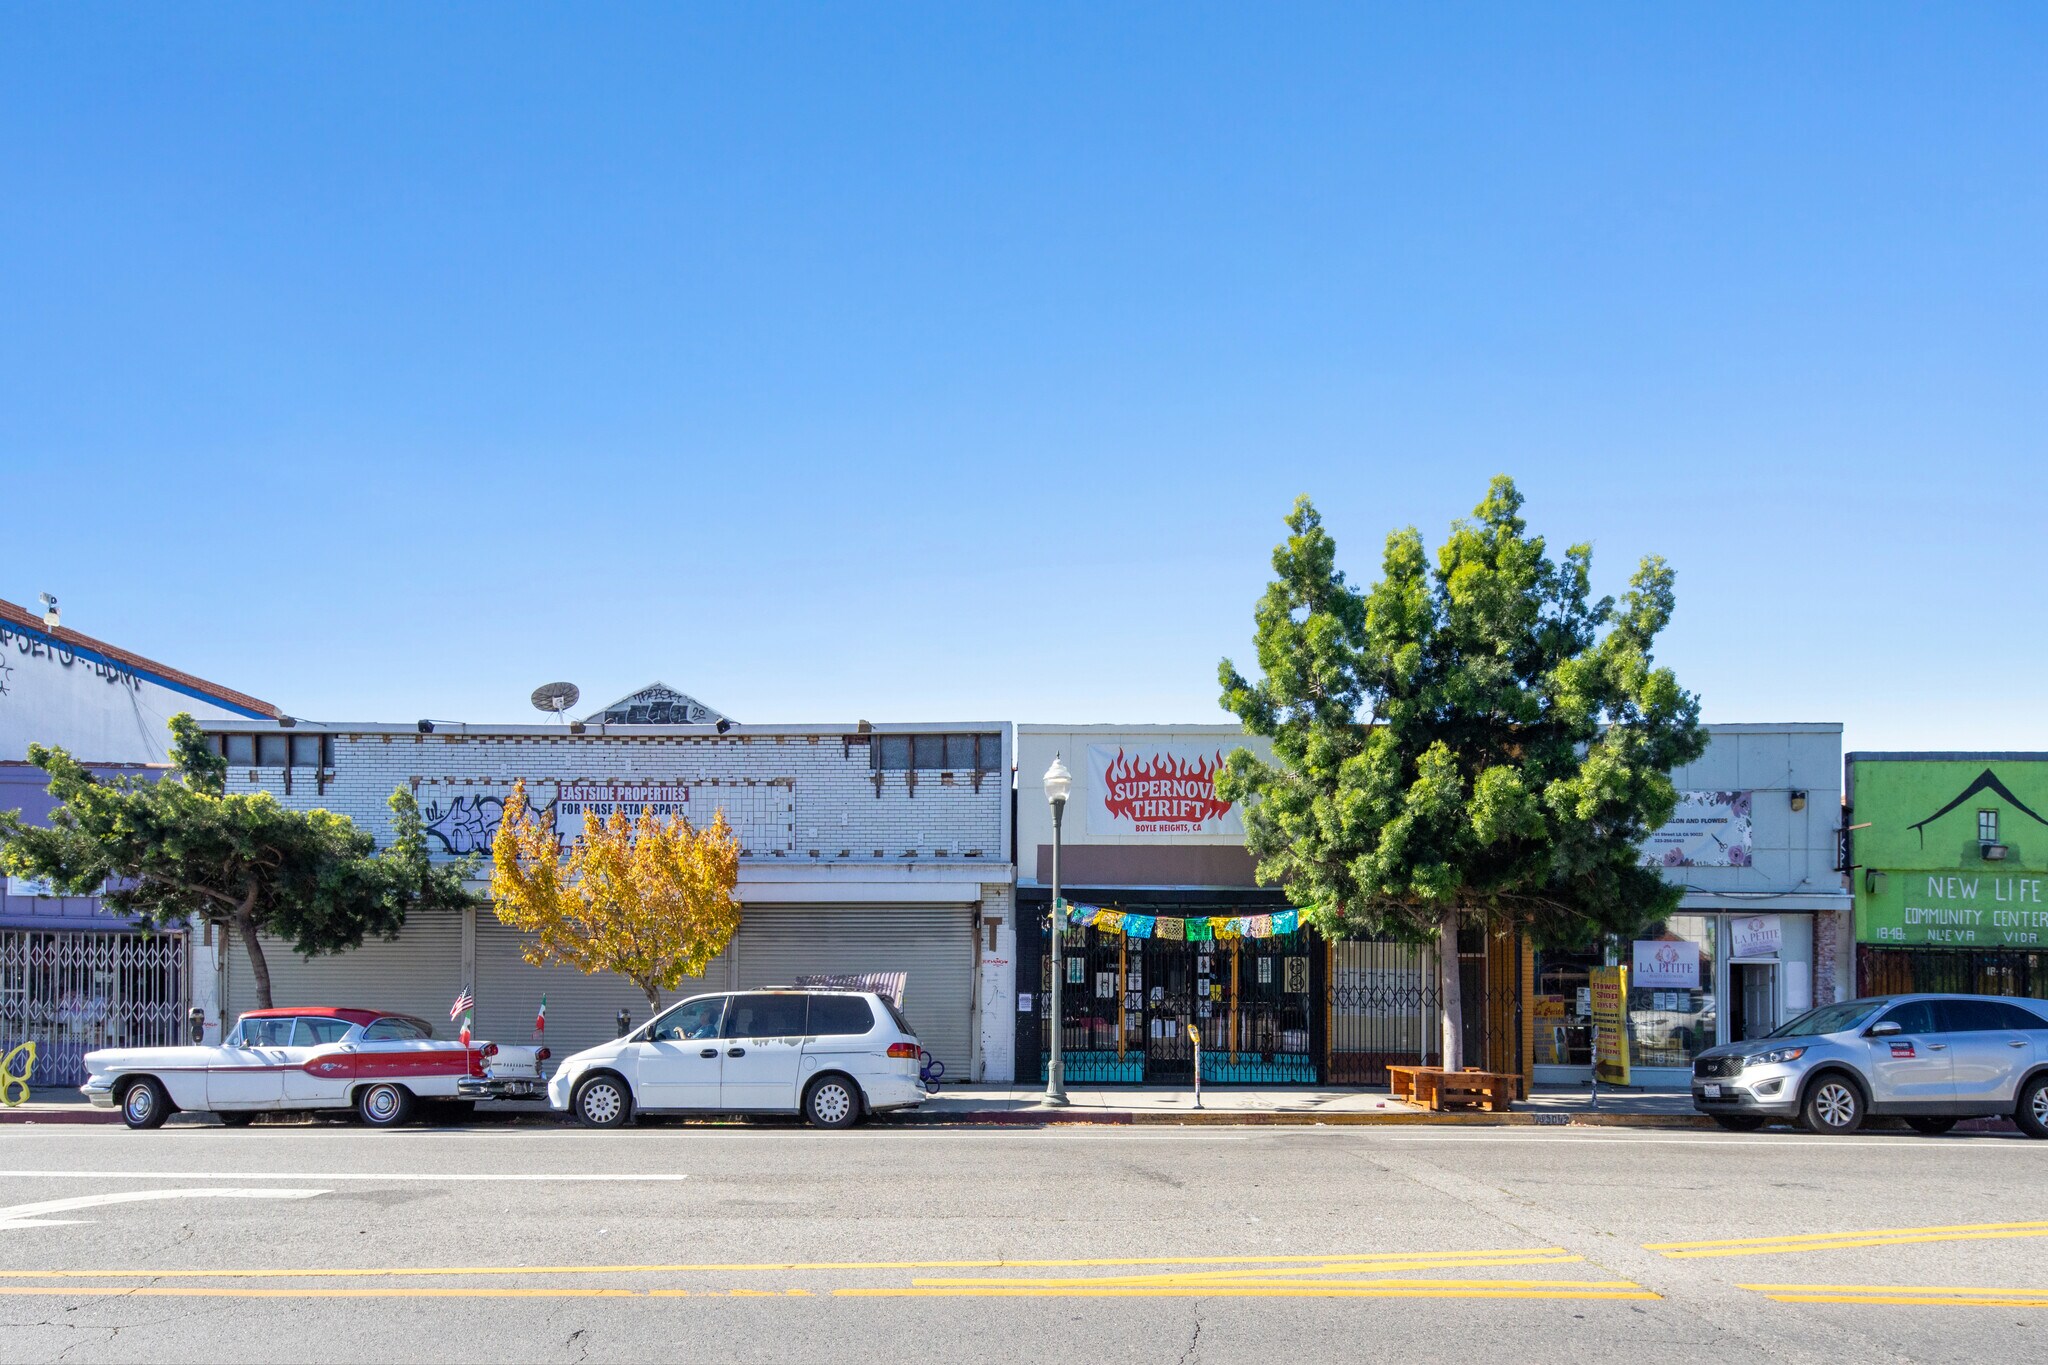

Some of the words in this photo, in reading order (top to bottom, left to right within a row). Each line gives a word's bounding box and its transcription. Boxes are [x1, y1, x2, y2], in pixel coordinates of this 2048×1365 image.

[561, 786, 615, 801] EASTSIDE
[617, 786, 687, 801] PROPERTIES
[561, 803, 581, 815] FOR
[1132, 799, 1205, 819] THRIFT
[1135, 824, 1157, 832] BOYLE
[1159, 824, 1191, 833] HEIGHTS,
[1192, 824, 1202, 832] CA
[1928, 876, 1979, 899] NEW
[1995, 878, 2041, 902] LIFE
[1905, 907, 1983, 925] COMMUNITY
[1993, 910, 2048, 928] CENTER
[1734, 934, 1747, 945] LA
[1927, 929, 1975, 942] NUEVA
[2003, 931, 2038, 943] VIDA
[1639, 962, 1654, 973] LA
